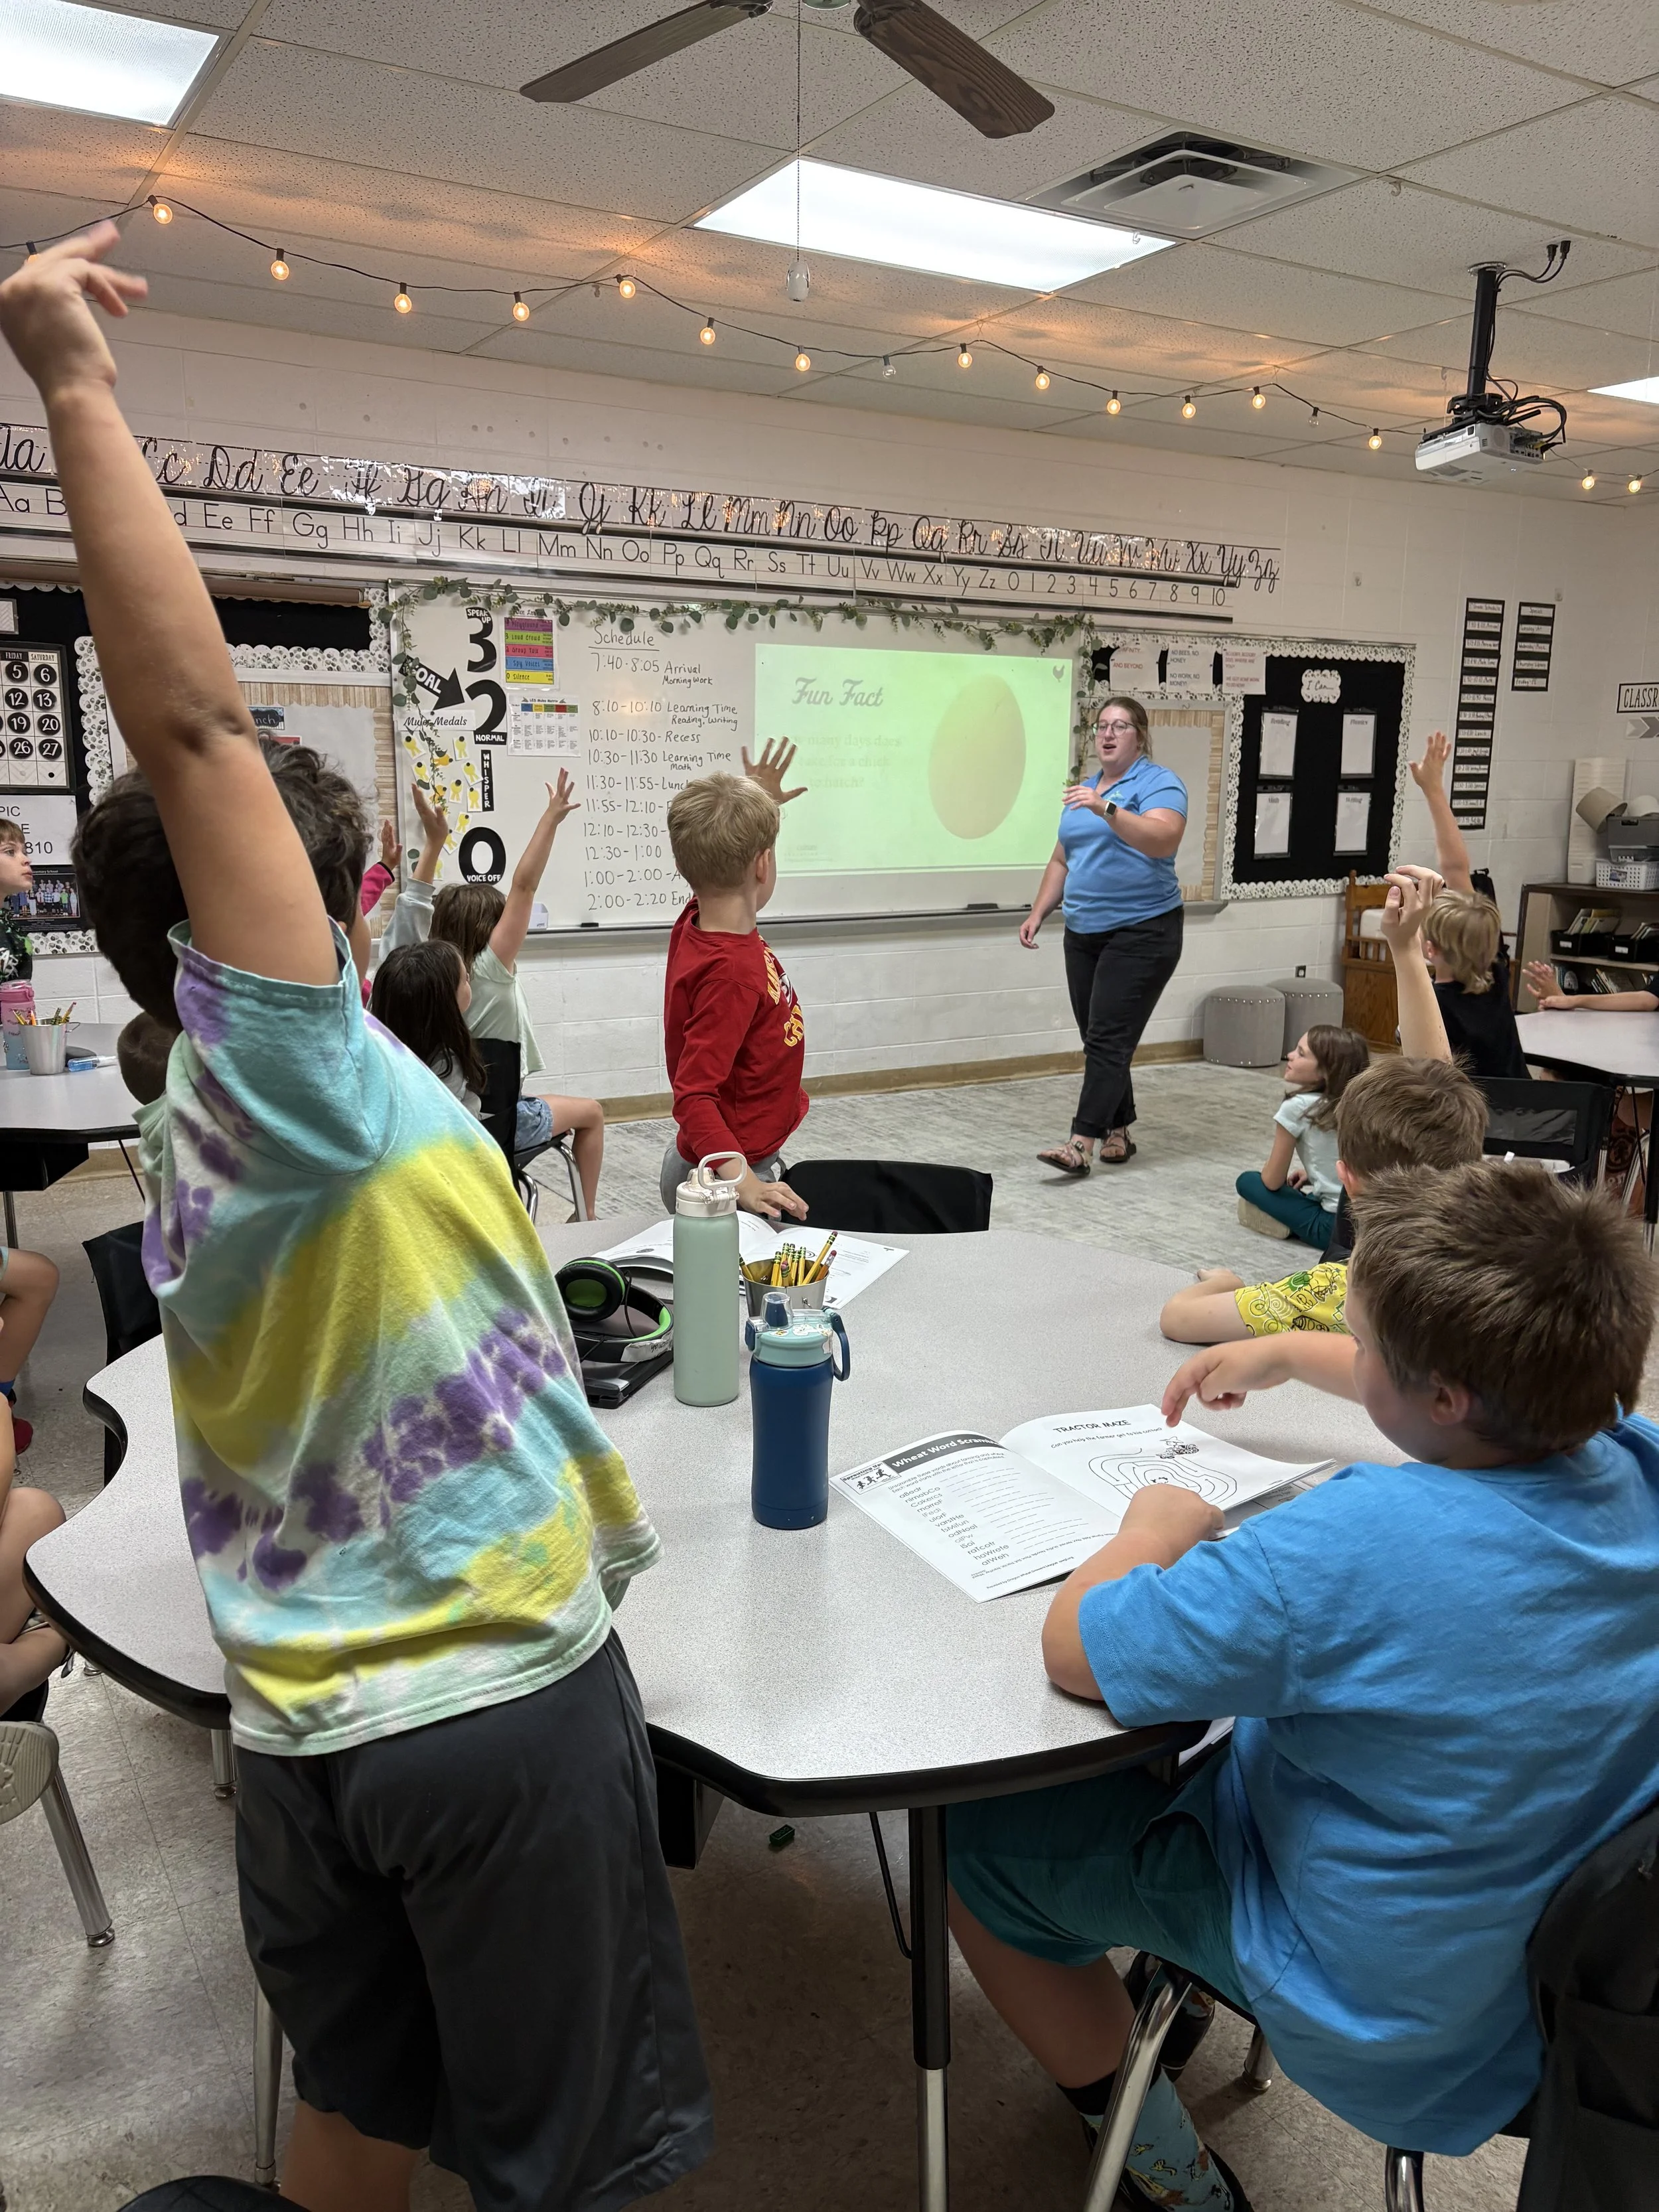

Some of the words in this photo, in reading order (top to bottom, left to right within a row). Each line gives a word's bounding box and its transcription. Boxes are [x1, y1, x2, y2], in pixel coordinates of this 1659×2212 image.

[203, 446, 263, 492] Dd
[281, 454, 319, 496] Ee
[579, 482, 611, 535] Jj
[628, 487, 666, 526] Kk
[681, 492, 717, 530] Ll
[824, 507, 859, 542] Oo
[871, 511, 903, 559] Pp
[1187, 541, 1212, 573] Xx
[1217, 544, 1246, 588] Yy
[1248, 549, 1280, 593] Zz
[204, 503, 233, 530] Ee
[250, 508, 275, 533] Ff
[293, 512, 328, 549] Gg
[343, 516, 374, 542] Hh
[388, 520, 401, 544] Ii
[419, 523, 441, 557] Jj
[459, 526, 486, 550] Kk
[539, 532, 576, 557] Mm
[586, 536, 613, 560] Nn
[622, 540, 650, 562] Oo
[664, 543, 684, 575] Pp
[695, 546, 725, 579] Qq
[734, 548, 754, 571] Rr
[768, 552, 786, 573] Ss
[796, 553, 816, 575] Tt
[828, 555, 849, 577] Uu
[861, 558, 879, 579] Vv
[887, 560, 916, 583] Ww
[923, 563, 943, 585] Xx
[953, 566, 970, 596] Yy
[979, 569, 995, 589] Zz
[1047, 573, 1056, 593] 2
[1066, 575, 1076, 594] 3
[1089, 577, 1098, 596] 4
[1109, 579, 1119, 597] 5
[1129, 581, 1137, 599] 6
[1149, 582, 1157, 600] 7
[1170, 584, 1179, 602] 8
[1191, 586, 1199, 604] 9
[1212, 588, 1225, 606] 10
[467, 608, 488, 617] SPEAK
[465, 607, 497, 672] 3
[595, 624, 655, 646] Schedule
[12, 665, 22, 678] 5
[40, 668, 50, 682] 6
[664, 661, 701, 674] Arrival
[662, 675, 691, 688] Morning
[9, 692, 25, 705] 12
[36, 693, 52, 707] 13
[792, 677, 832, 705] Fun
[839, 678, 884, 707] Fact
[465, 679, 506, 731] 2
[668, 701, 709, 718] Learning
[712, 704, 737, 714] Time
[11, 717, 27, 730] 19
[41, 718, 58, 731] 20
[433, 716, 467, 725] Medals
[665, 731, 700, 743] Recess
[14, 741, 31, 755] 26
[42, 743, 58, 756] 27
[664, 751, 703, 767] Learning
[707, 752, 731, 761] Time
[1053, 1422, 1100, 1434] TRACTOR
[891, 1449, 928, 1468] Wheat
[927, 1440, 958, 1454] Word
[899, 1487, 922, 1499] aBedr
[905, 1487, 940, 1503] nimebCo
[910, 1493, 943, 1508] Cakercs
[917, 1499, 943, 1513] marreF
[935, 1514, 964, 1527] varstHe
[948, 1524, 978, 1538] odNoel
[968, 1540, 996, 1555] raTcotr
[974, 1544, 1009, 1560] haWrete
[981, 1552, 1009, 1566] atWeh
